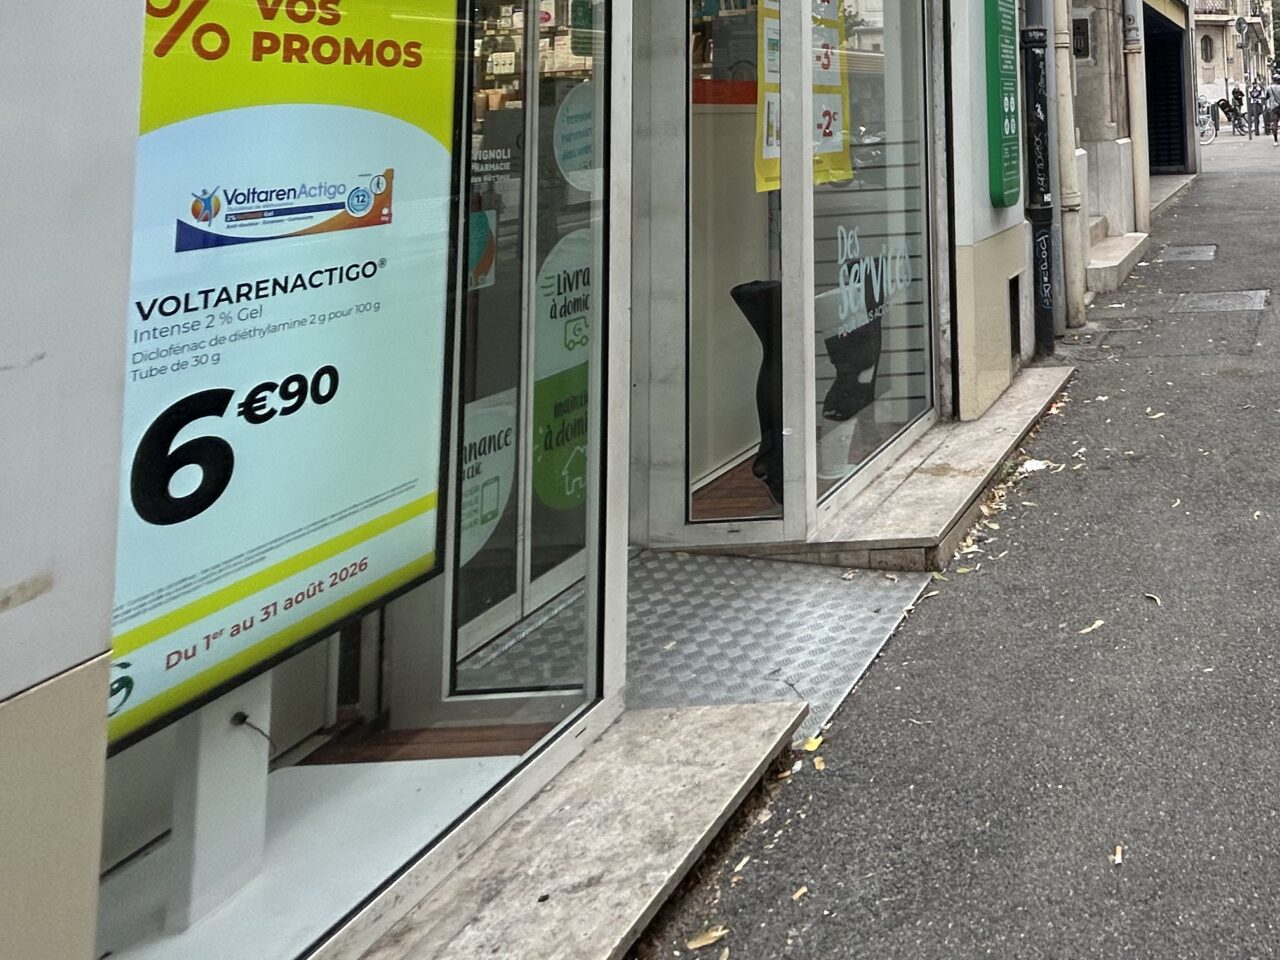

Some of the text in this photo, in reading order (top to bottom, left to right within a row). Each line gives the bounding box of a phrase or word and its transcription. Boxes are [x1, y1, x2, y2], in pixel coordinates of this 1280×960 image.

[252, 31, 423, 69] PROMOS
[837, 224, 860, 265] Des
[556, 266, 590, 297] Livra
[133, 305, 263, 344] Intense 2 % Gel
[550, 298, 557, 319] à
[131, 340, 206, 365] Diclofénac
[208, 334, 227, 347] de
[328, 306, 353, 323] pour
[355, 301, 373, 314] 100
[131, 352, 221, 382] Tube de 30 g
[165, 644, 198, 671] Du
[229, 616, 255, 638] au
[259, 601, 279, 623] 31
[283, 578, 325, 611] août
[328, 556, 369, 588] 2026
